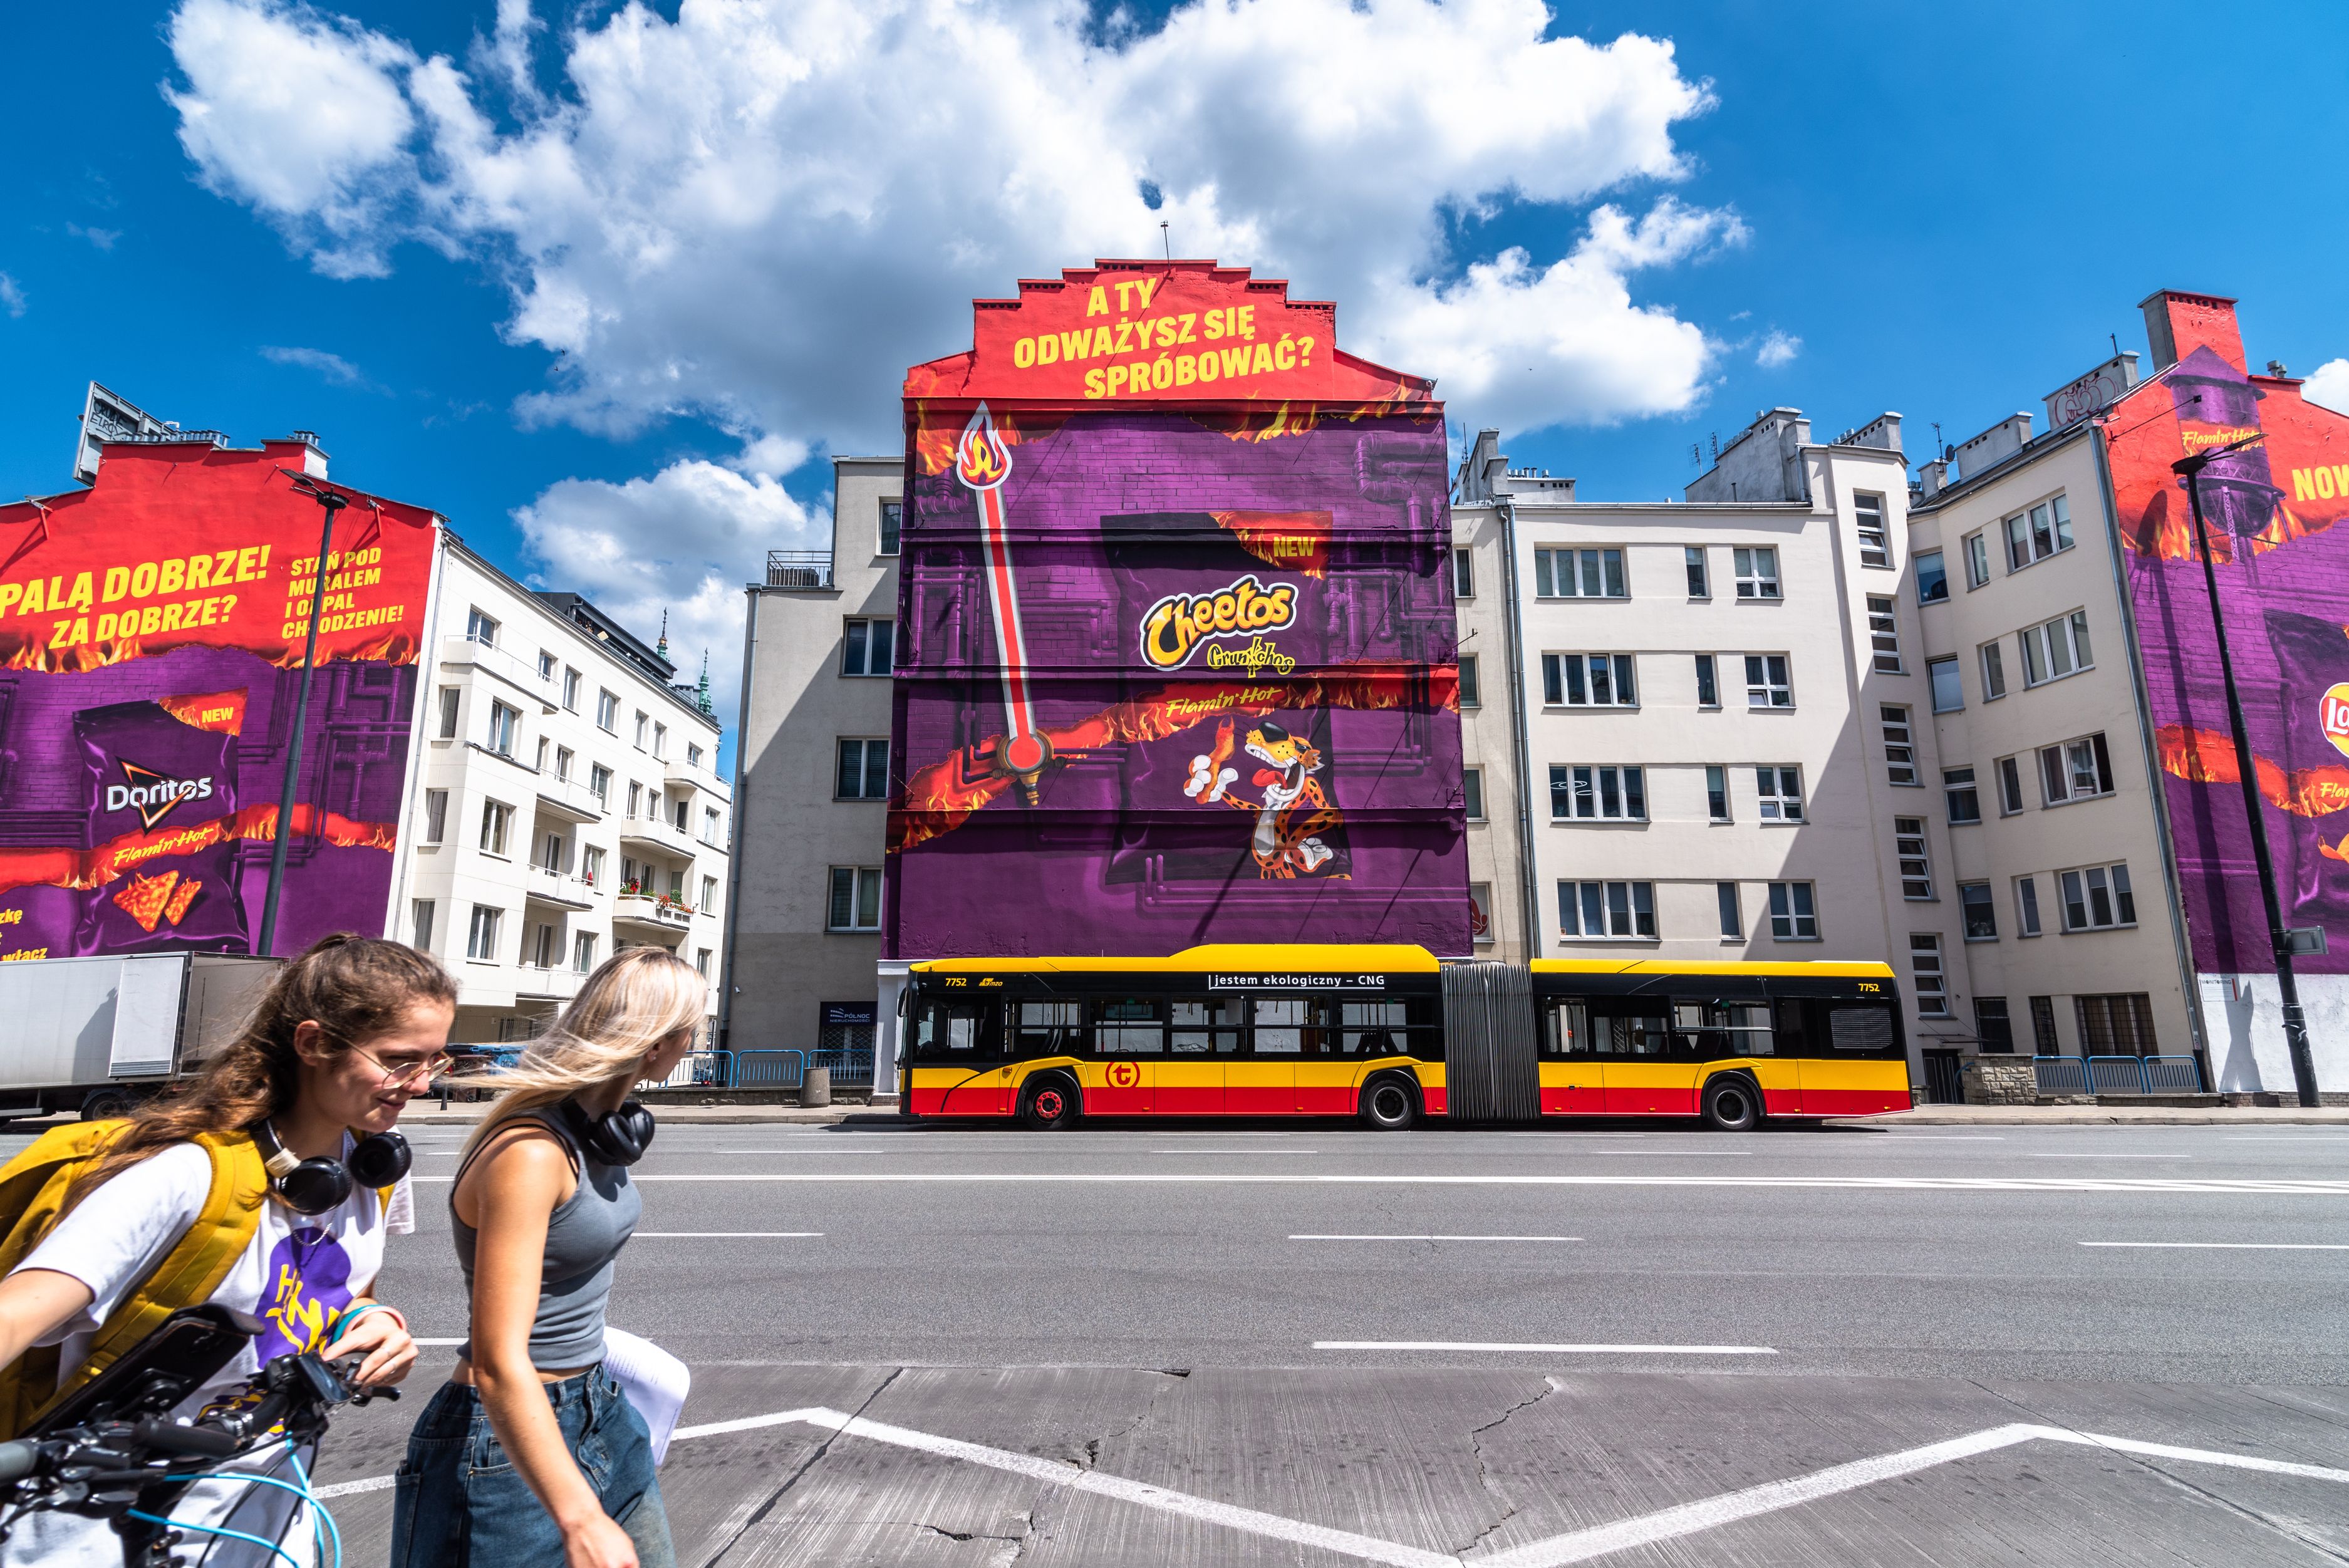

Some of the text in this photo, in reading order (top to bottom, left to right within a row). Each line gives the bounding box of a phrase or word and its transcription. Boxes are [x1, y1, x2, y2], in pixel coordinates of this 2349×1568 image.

[1086, 278, 1157, 317] A TY
[1014, 304, 1255, 369] ODWAŻYSZ SIĘ
[1084, 333, 1315, 399] SPRÓBOWAĆ?
[343, 547, 381, 568] POD
[1273, 536, 1316, 557] NEW
[0, 544, 271, 619] PALĄ DOBRZE!
[48, 594, 238, 650] ZA DOBRZE?
[282, 605, 404, 639] CHODZENIE!
[285, 602, 293, 619] I
[1144, 579, 1294, 668] Cheetos
[1240, 687, 1282, 704] Hot
[202, 707, 234, 723] NEW
[106, 777, 214, 812] Doritos
[945, 978, 967, 987] 7752
[1215, 975, 1258, 987] jestem
[1263, 975, 1341, 987] ekologiczny
[1358, 975, 1385, 985] CNG
[1858, 983, 1880, 992] 7752
